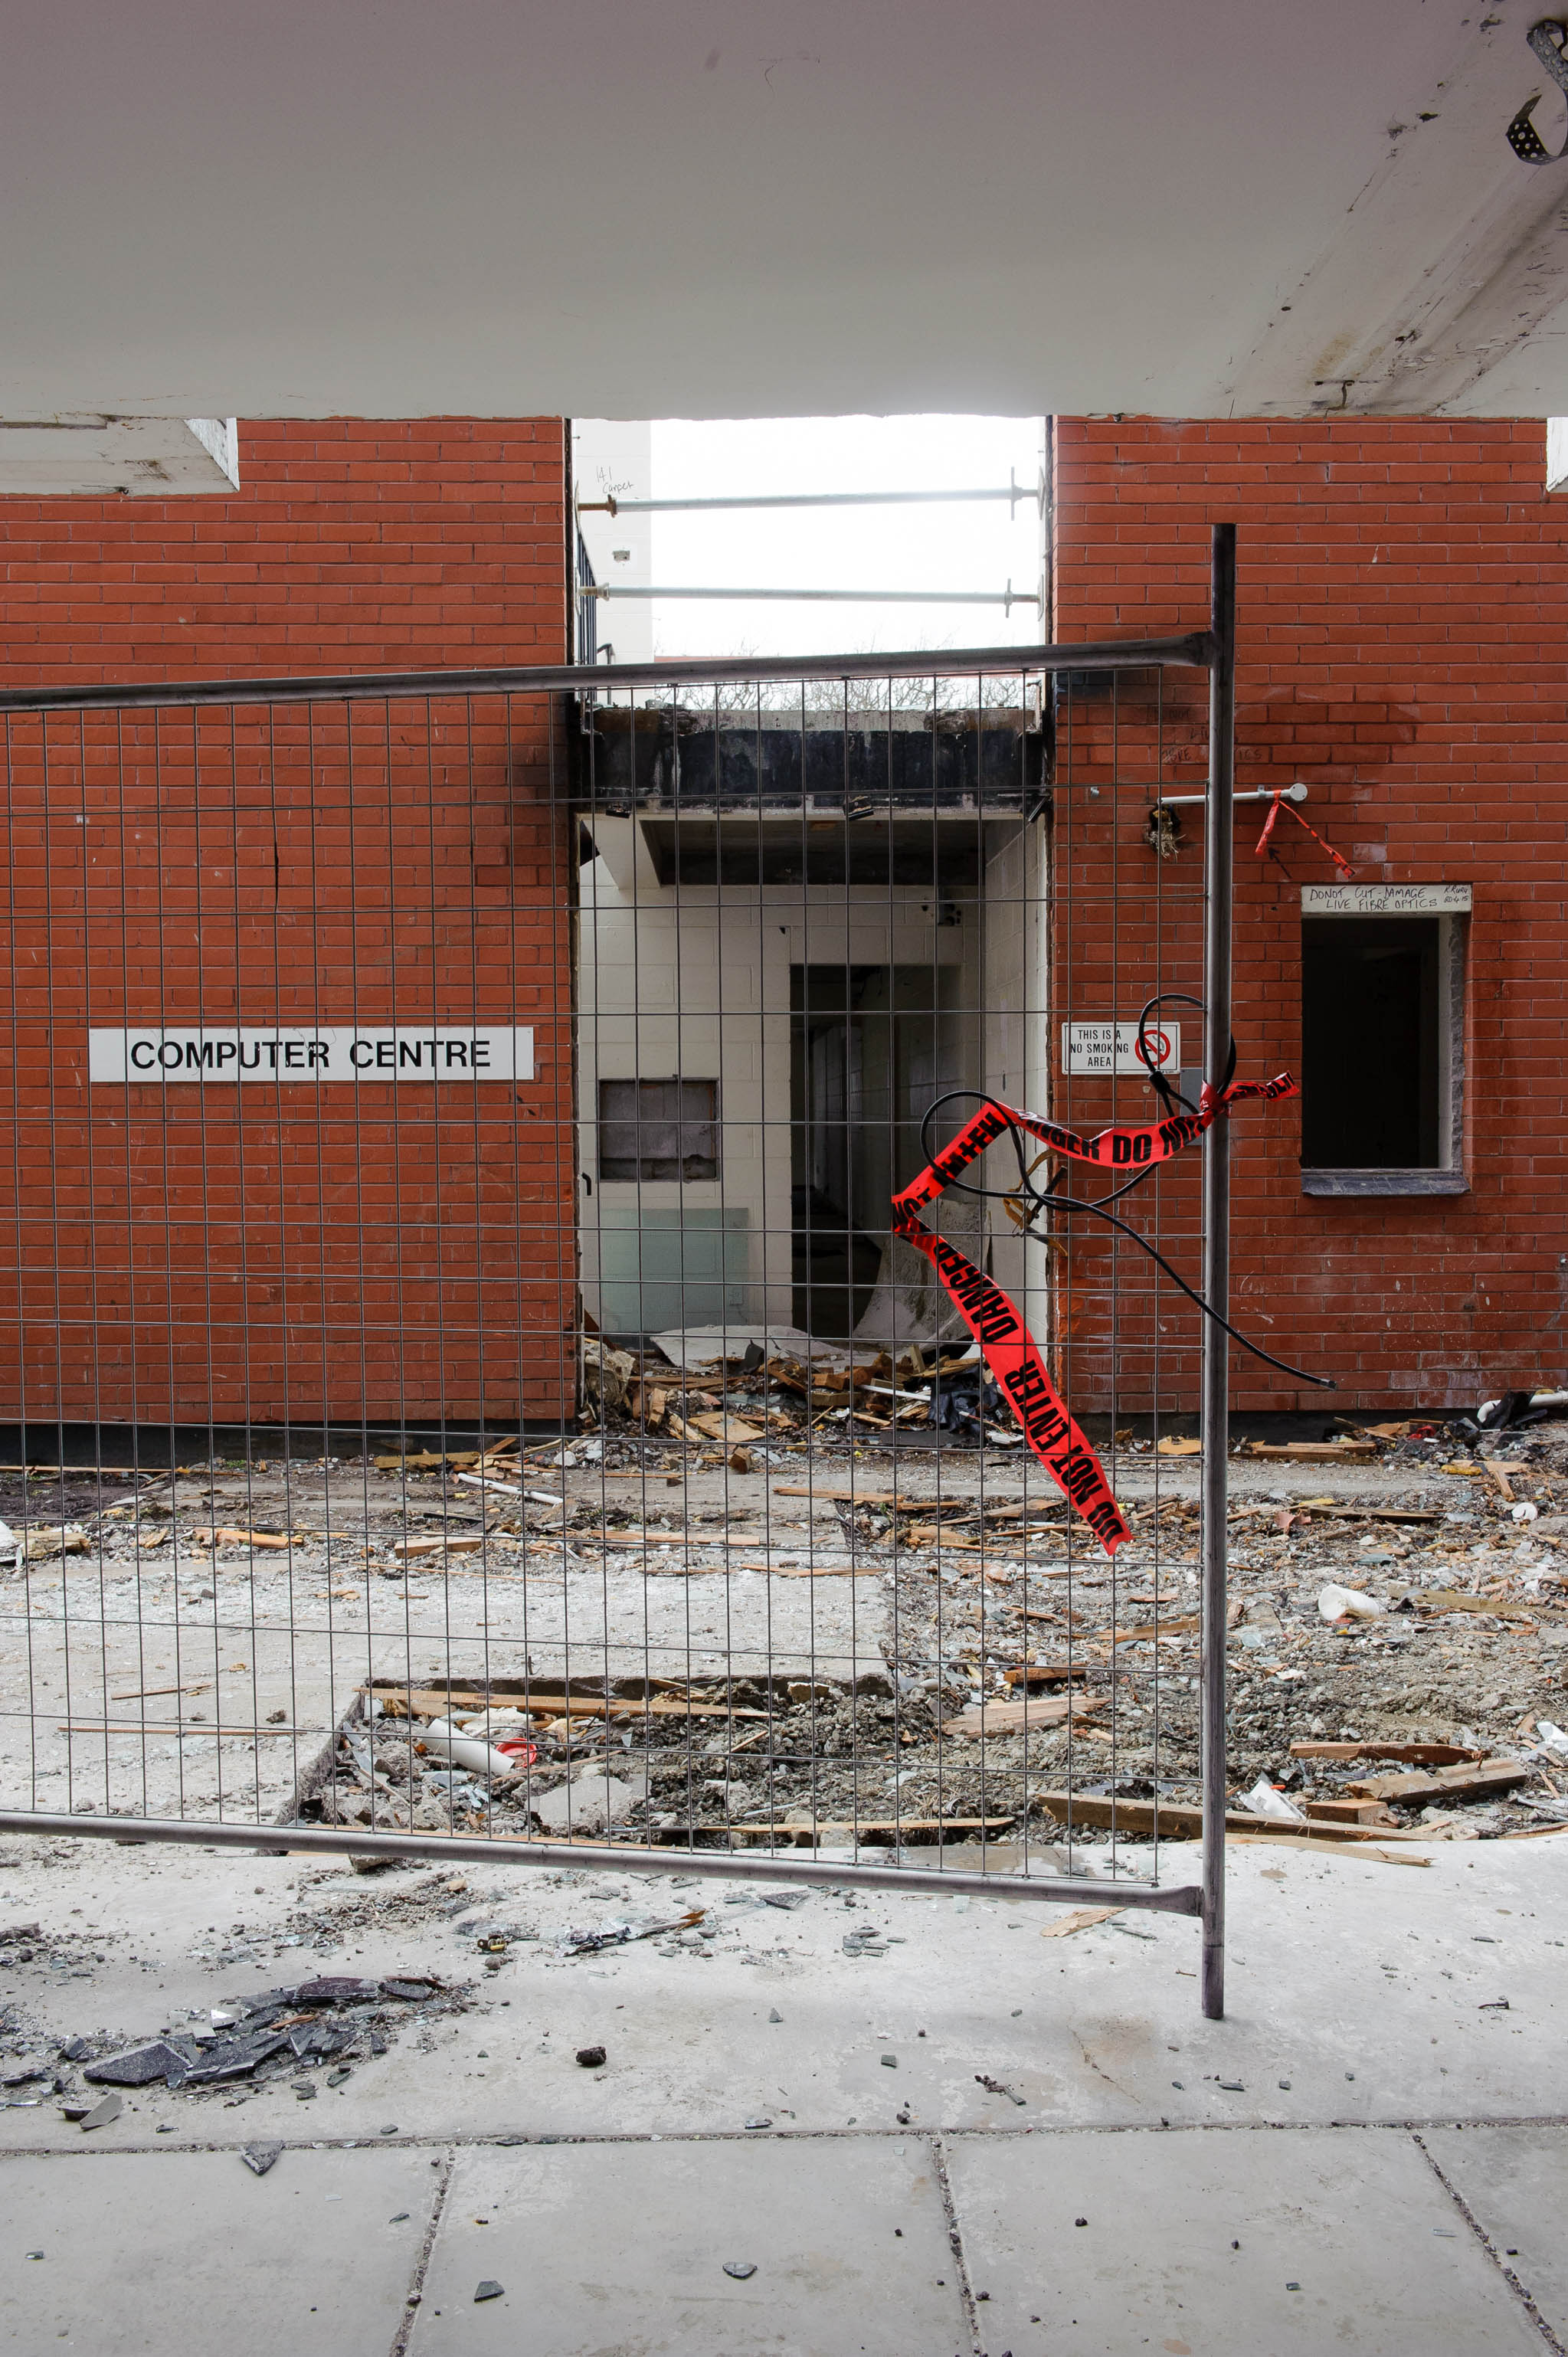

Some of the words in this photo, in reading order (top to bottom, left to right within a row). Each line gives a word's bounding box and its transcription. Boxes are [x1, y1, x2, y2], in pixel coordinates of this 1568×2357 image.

[596, 465, 612, 483] 141
[603, 480, 634, 494] Carpet
[1326, 899, 1351, 909] LIVE
[1359, 899, 1390, 910] FIBRE
[1395, 898, 1438, 909] OPTICS
[1078, 1030, 1098, 1039] THIS
[1102, 1030, 1111, 1039] IS
[1115, 1030, 1121, 1039] A
[131, 1040, 330, 1069] COMPUTER
[349, 1040, 491, 1069] CENTRE
[1070, 1043, 1082, 1053] NO
[1087, 1043, 1128, 1053] SMOKNG
[1088, 1057, 1111, 1066] AREA
[1112, 1134, 1152, 1164] DO
[1003, 1359, 1069, 1452] ENTER
[1049, 1445, 1104, 1507] NOT
[1086, 1500, 1124, 1546] DO
